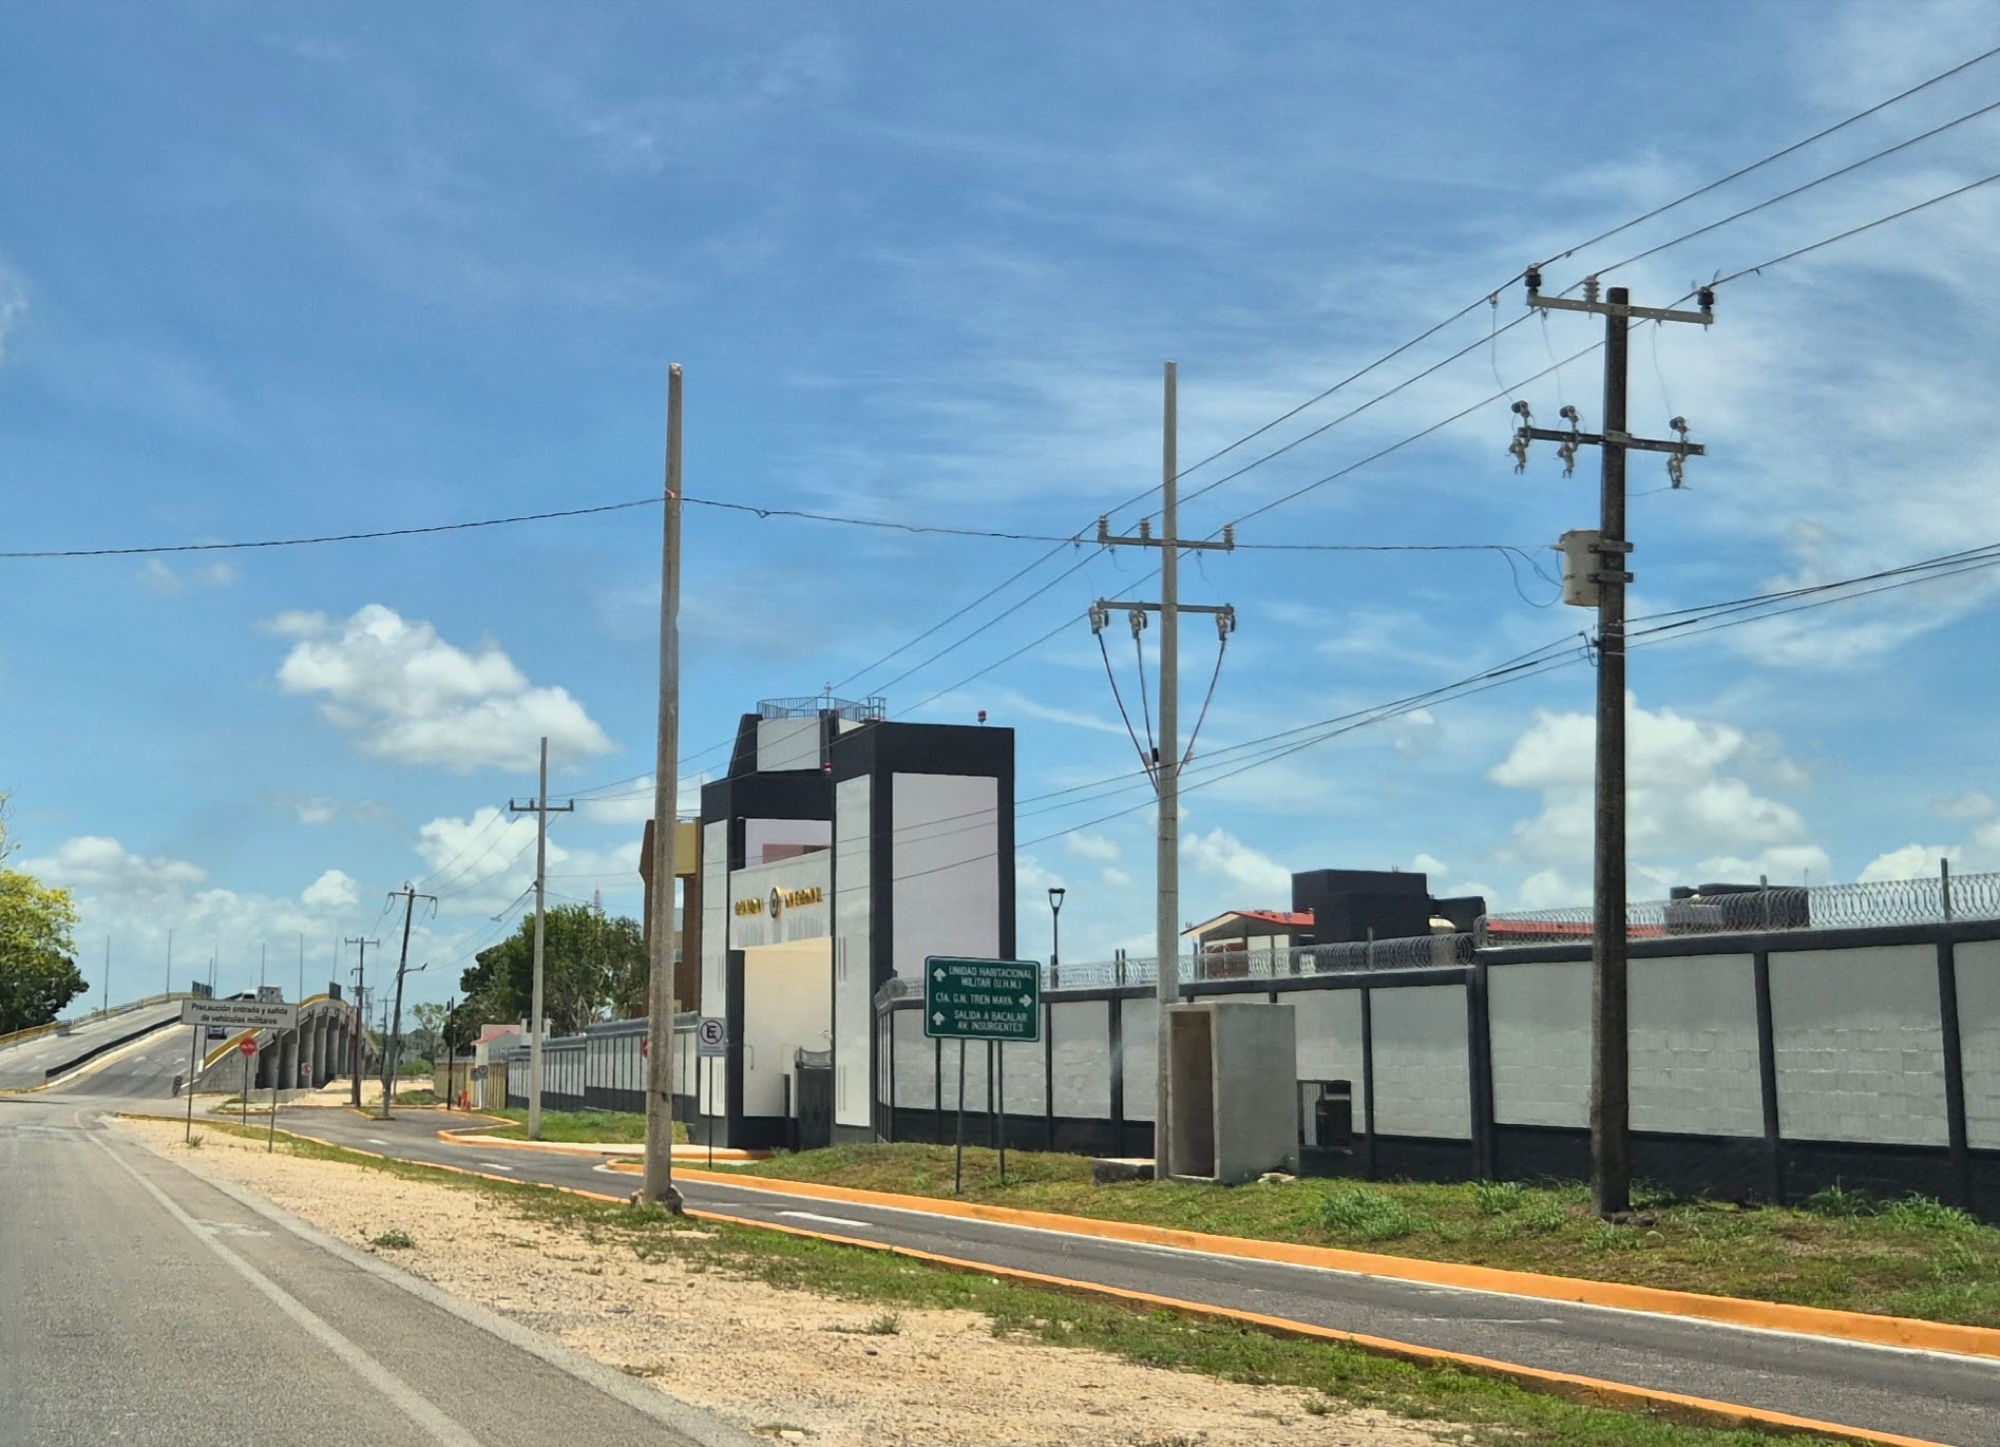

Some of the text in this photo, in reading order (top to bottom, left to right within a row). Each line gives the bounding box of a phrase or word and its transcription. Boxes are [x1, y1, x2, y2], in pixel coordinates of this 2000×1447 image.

[949, 966, 1033, 979] UNIDAD HABITACIONAL
[961, 977, 991, 988] MILITAR
[970, 994, 990, 1005] TREN
[992, 995, 1013, 1006] MAYA
[954, 1010, 1028, 1023] SALIDA A BACALAR
[971, 1021, 1024, 1032] INSURGENTES
